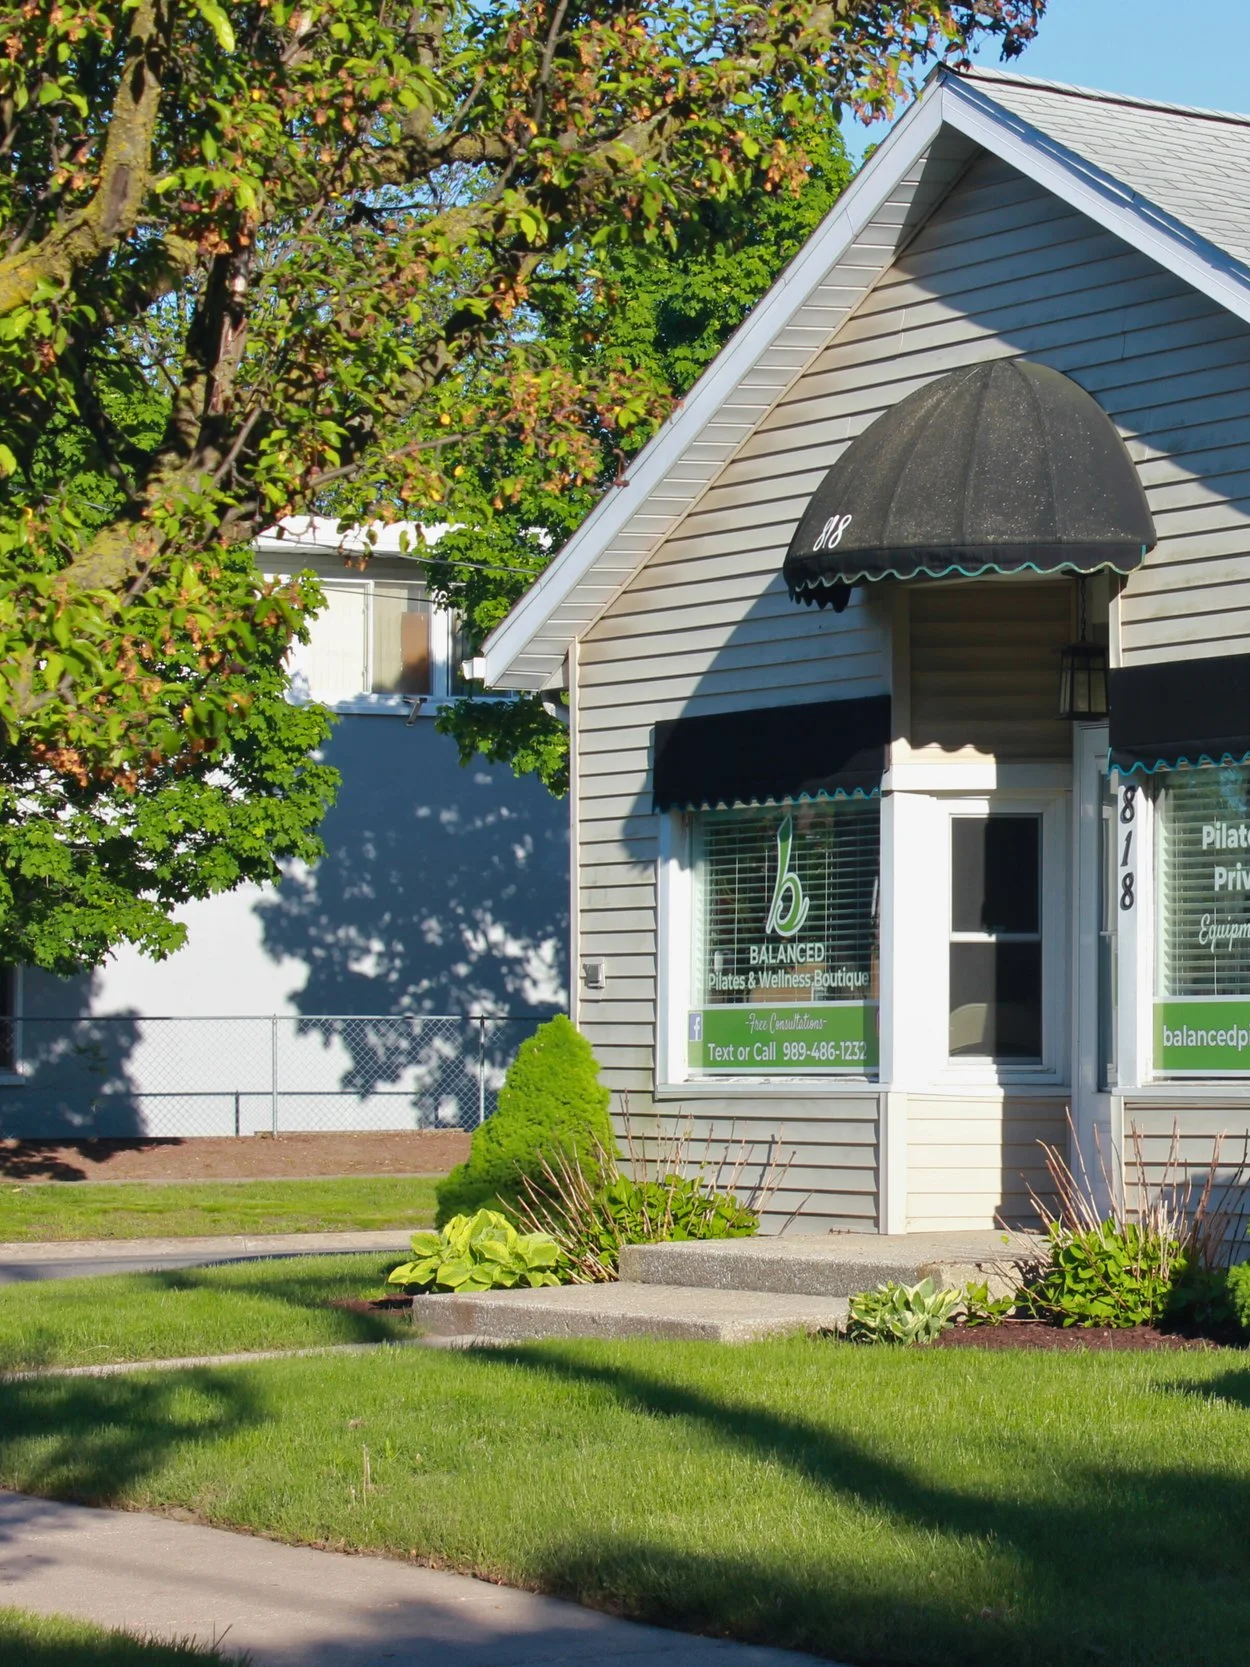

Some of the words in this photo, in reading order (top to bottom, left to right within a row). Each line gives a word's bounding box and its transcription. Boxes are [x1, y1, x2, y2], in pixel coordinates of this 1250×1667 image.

[813, 514, 853, 552] 818
[1120, 785, 1136, 911] 818
[749, 942, 825, 965] BALANCED
[708, 970, 746, 991] Pilates
[747, 971, 756, 989] &
[758, 968, 811, 989] Wellness
[813, 967, 869, 991] Boutique
[707, 1043, 734, 1061] Text
[737, 1046, 750, 1061] or
[753, 1041, 777, 1061] Call
[783, 1041, 867, 1061] 989-486-1232
